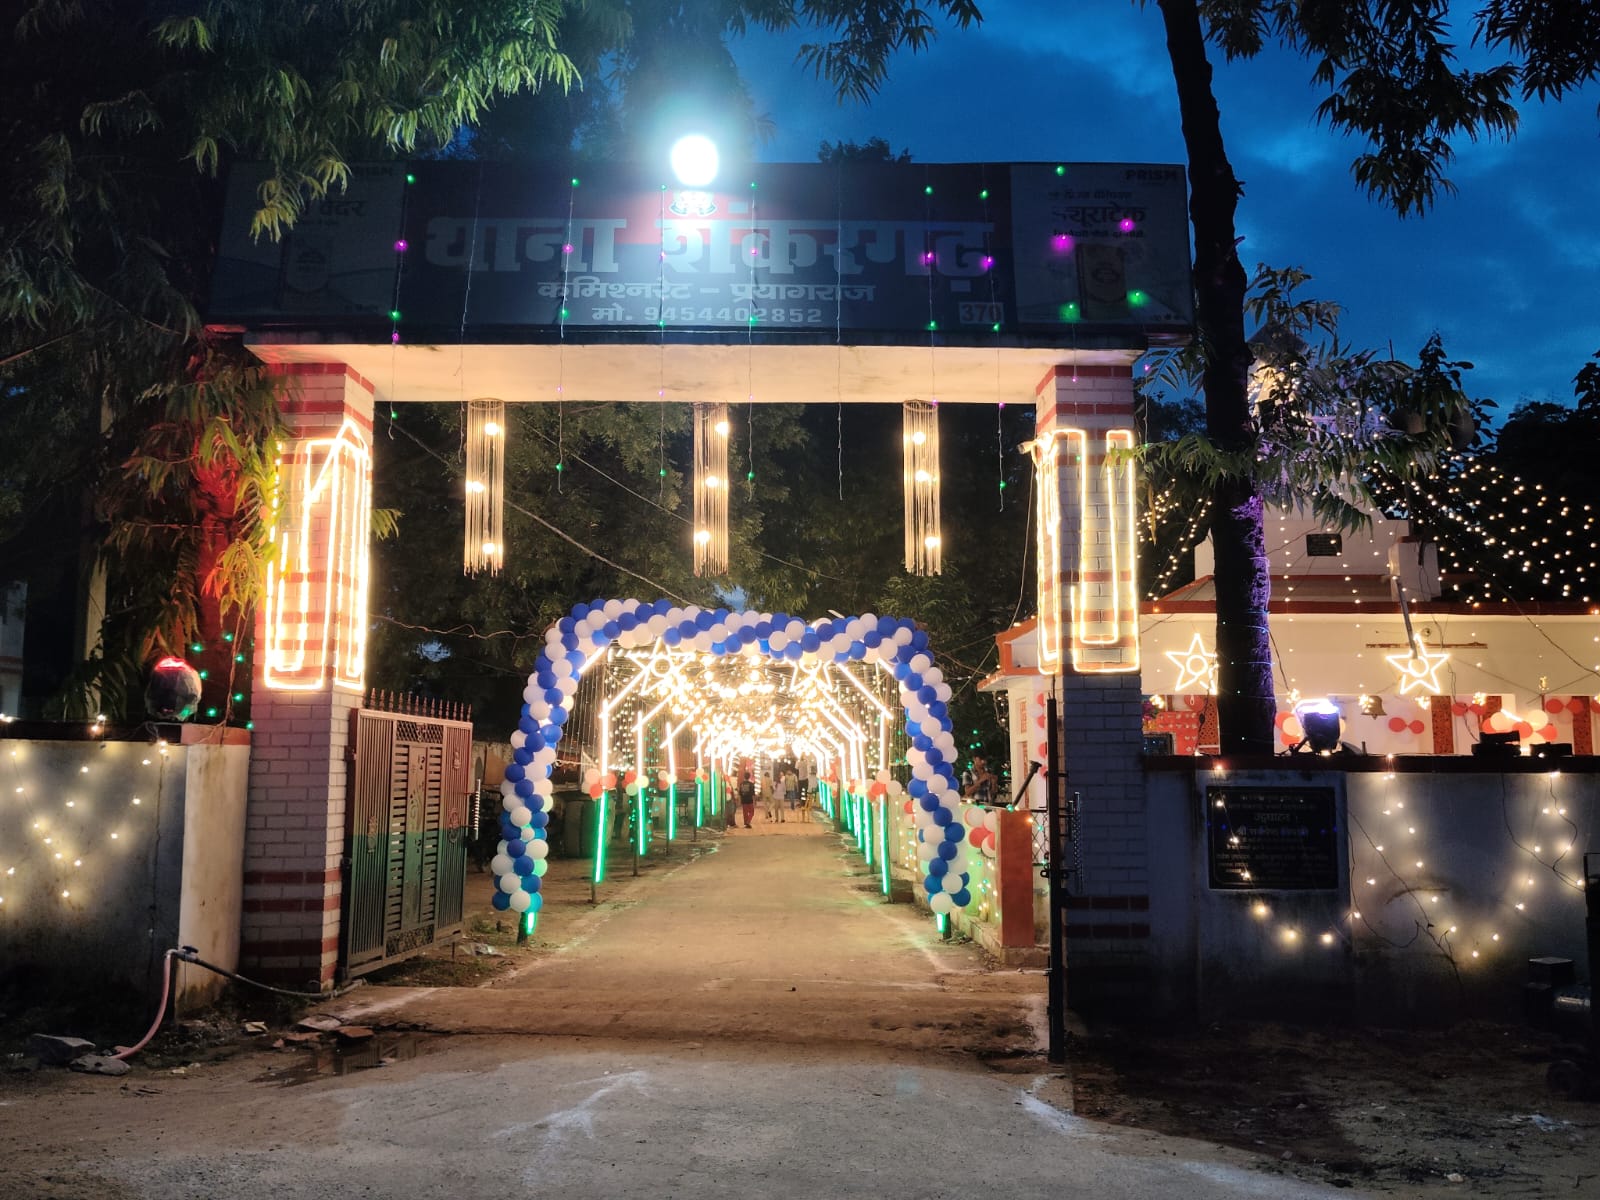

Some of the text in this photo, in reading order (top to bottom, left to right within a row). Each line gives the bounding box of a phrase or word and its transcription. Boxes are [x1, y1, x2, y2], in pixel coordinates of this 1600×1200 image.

[1126, 168, 1177, 181] PRISM
[425, 216, 626, 274] थाना
[537, 276, 692, 301] कमिश्नरेट
[729, 281, 876, 302] प्रयागराज
[592, 300, 823, 324] मो. 9454402852
